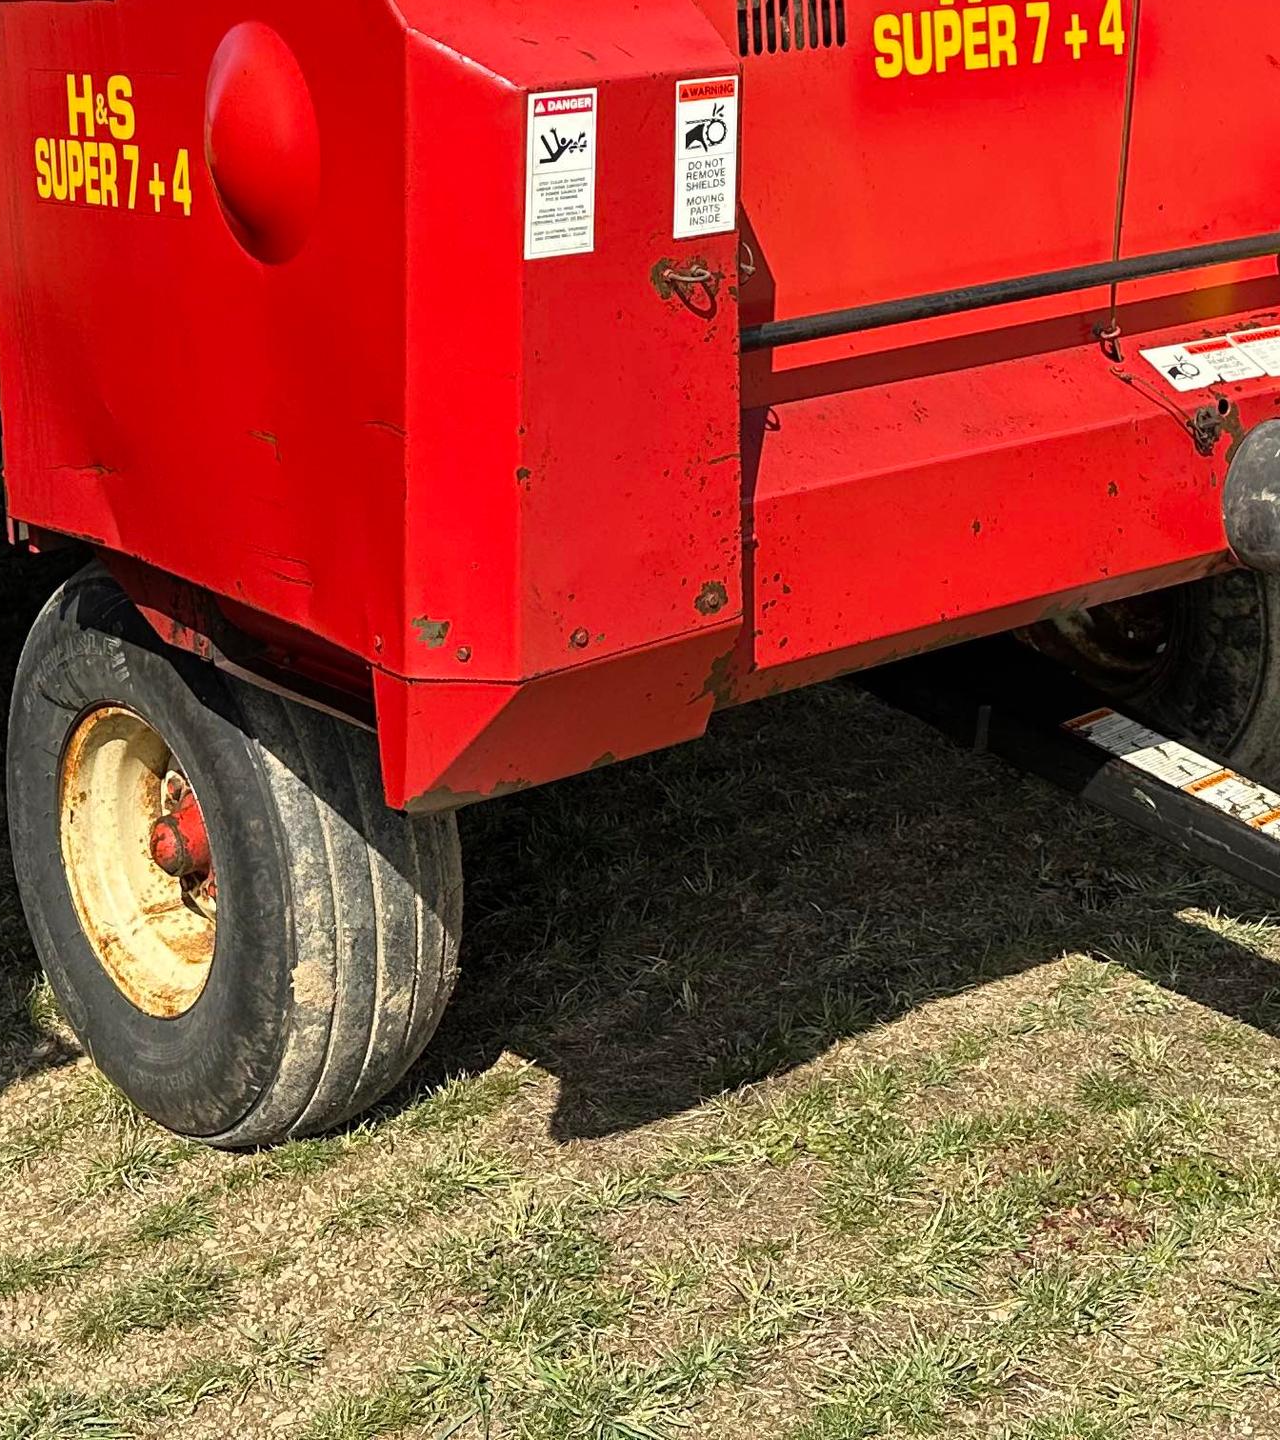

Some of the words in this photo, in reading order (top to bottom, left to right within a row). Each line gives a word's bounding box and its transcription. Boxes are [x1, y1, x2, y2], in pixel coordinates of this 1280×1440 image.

[873, 3, 1017, 79] SUPER
[1026, 2, 1050, 63] 7
[689, 84, 735, 97] WARNING
[66, 73, 136, 141] H&S
[547, 97, 592, 113] DANGER
[688, 161, 703, 171] DO
[705, 158, 725, 170] NOT
[35, 137, 119, 208] SUPER
[123, 144, 139, 210] 7
[172, 148, 192, 217] 4
[686, 169, 726, 181] REMOVE
[686, 178, 726, 192] SHIELDS
[686, 193, 725, 207] MOVING
[690, 204, 721, 215] PARTS
[689, 214, 721, 227] INSIDE
